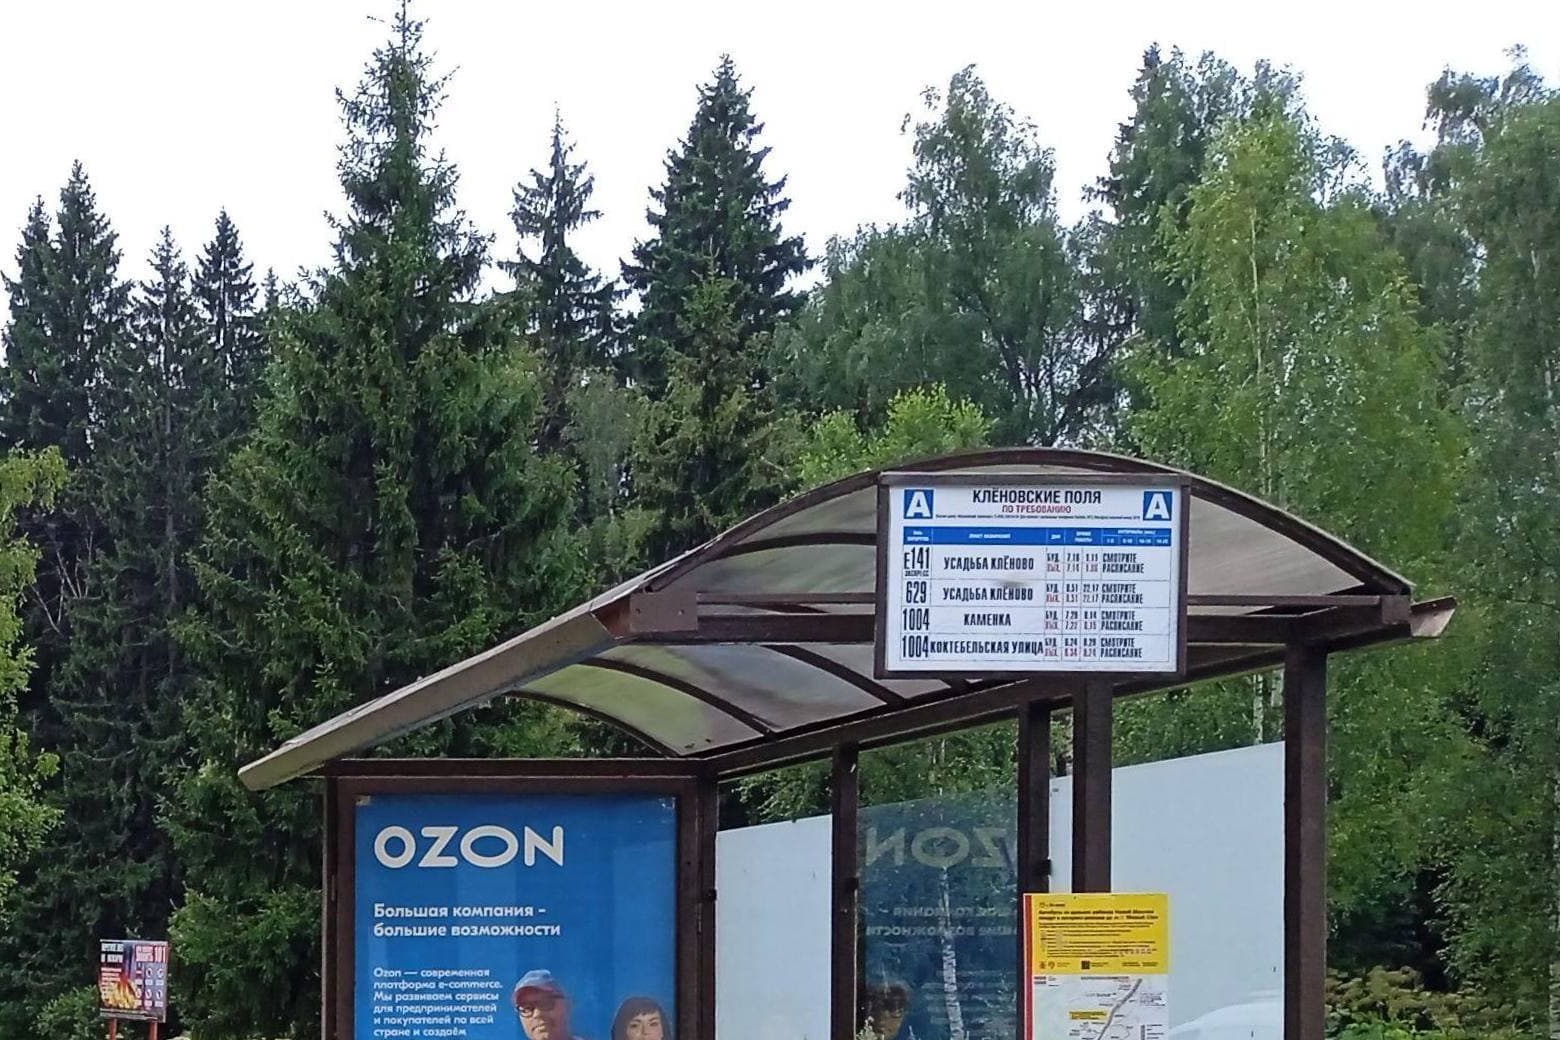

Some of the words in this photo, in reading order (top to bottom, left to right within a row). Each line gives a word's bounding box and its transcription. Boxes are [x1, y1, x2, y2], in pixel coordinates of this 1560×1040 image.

[972, 487, 1060, 504] КЛЁНОВСКИЕ
[1065, 490, 1101, 504] ПОЛЯ
[905, 491, 932, 518] А
[1002, 505, 1014, 514] ПО
[1144, 493, 1170, 519] А
[943, 557, 988, 571] УСАДЬБА
[990, 555, 1034, 570] КЛЁНОВО
[906, 581, 927, 604] 629
[943, 587, 988, 602] УСАДЬБА
[990, 585, 1033, 601] КЛЁНОВО
[902, 608, 929, 631] 1004
[964, 613, 1012, 626] КАМЕНКА
[902, 635, 929, 658] 1004
[930, 641, 1009, 654] КОКТЕБЕЛЬСКАЯ
[1011, 641, 1044, 656] УЛИЦА
[374, 825, 564, 869] OZON
[374, 903, 448, 918] Большая
[453, 906, 534, 918] компания
[373, 922, 447, 937] большие
[451, 925, 561, 937] возможности
[373, 967, 401, 978] Ozon
[420, 969, 490, 979] современная
[373, 980, 436, 991] платформа
[373, 992, 392, 1001] Мы
[395, 993, 453, 1003] развиваем
[455, 993, 500, 1003] сервисы
[373, 1005, 393, 1014] для
[396, 1003, 497, 1014] предпринимателей
[374, 1016, 381, 1024] и
[384, 1015, 451, 1027] покупателей
[454, 1016, 467, 1024] по
[469, 1014, 494, 1024] всей
[373, 1029, 410, 1038] стране
[423, 1027, 467, 1037] создаём
